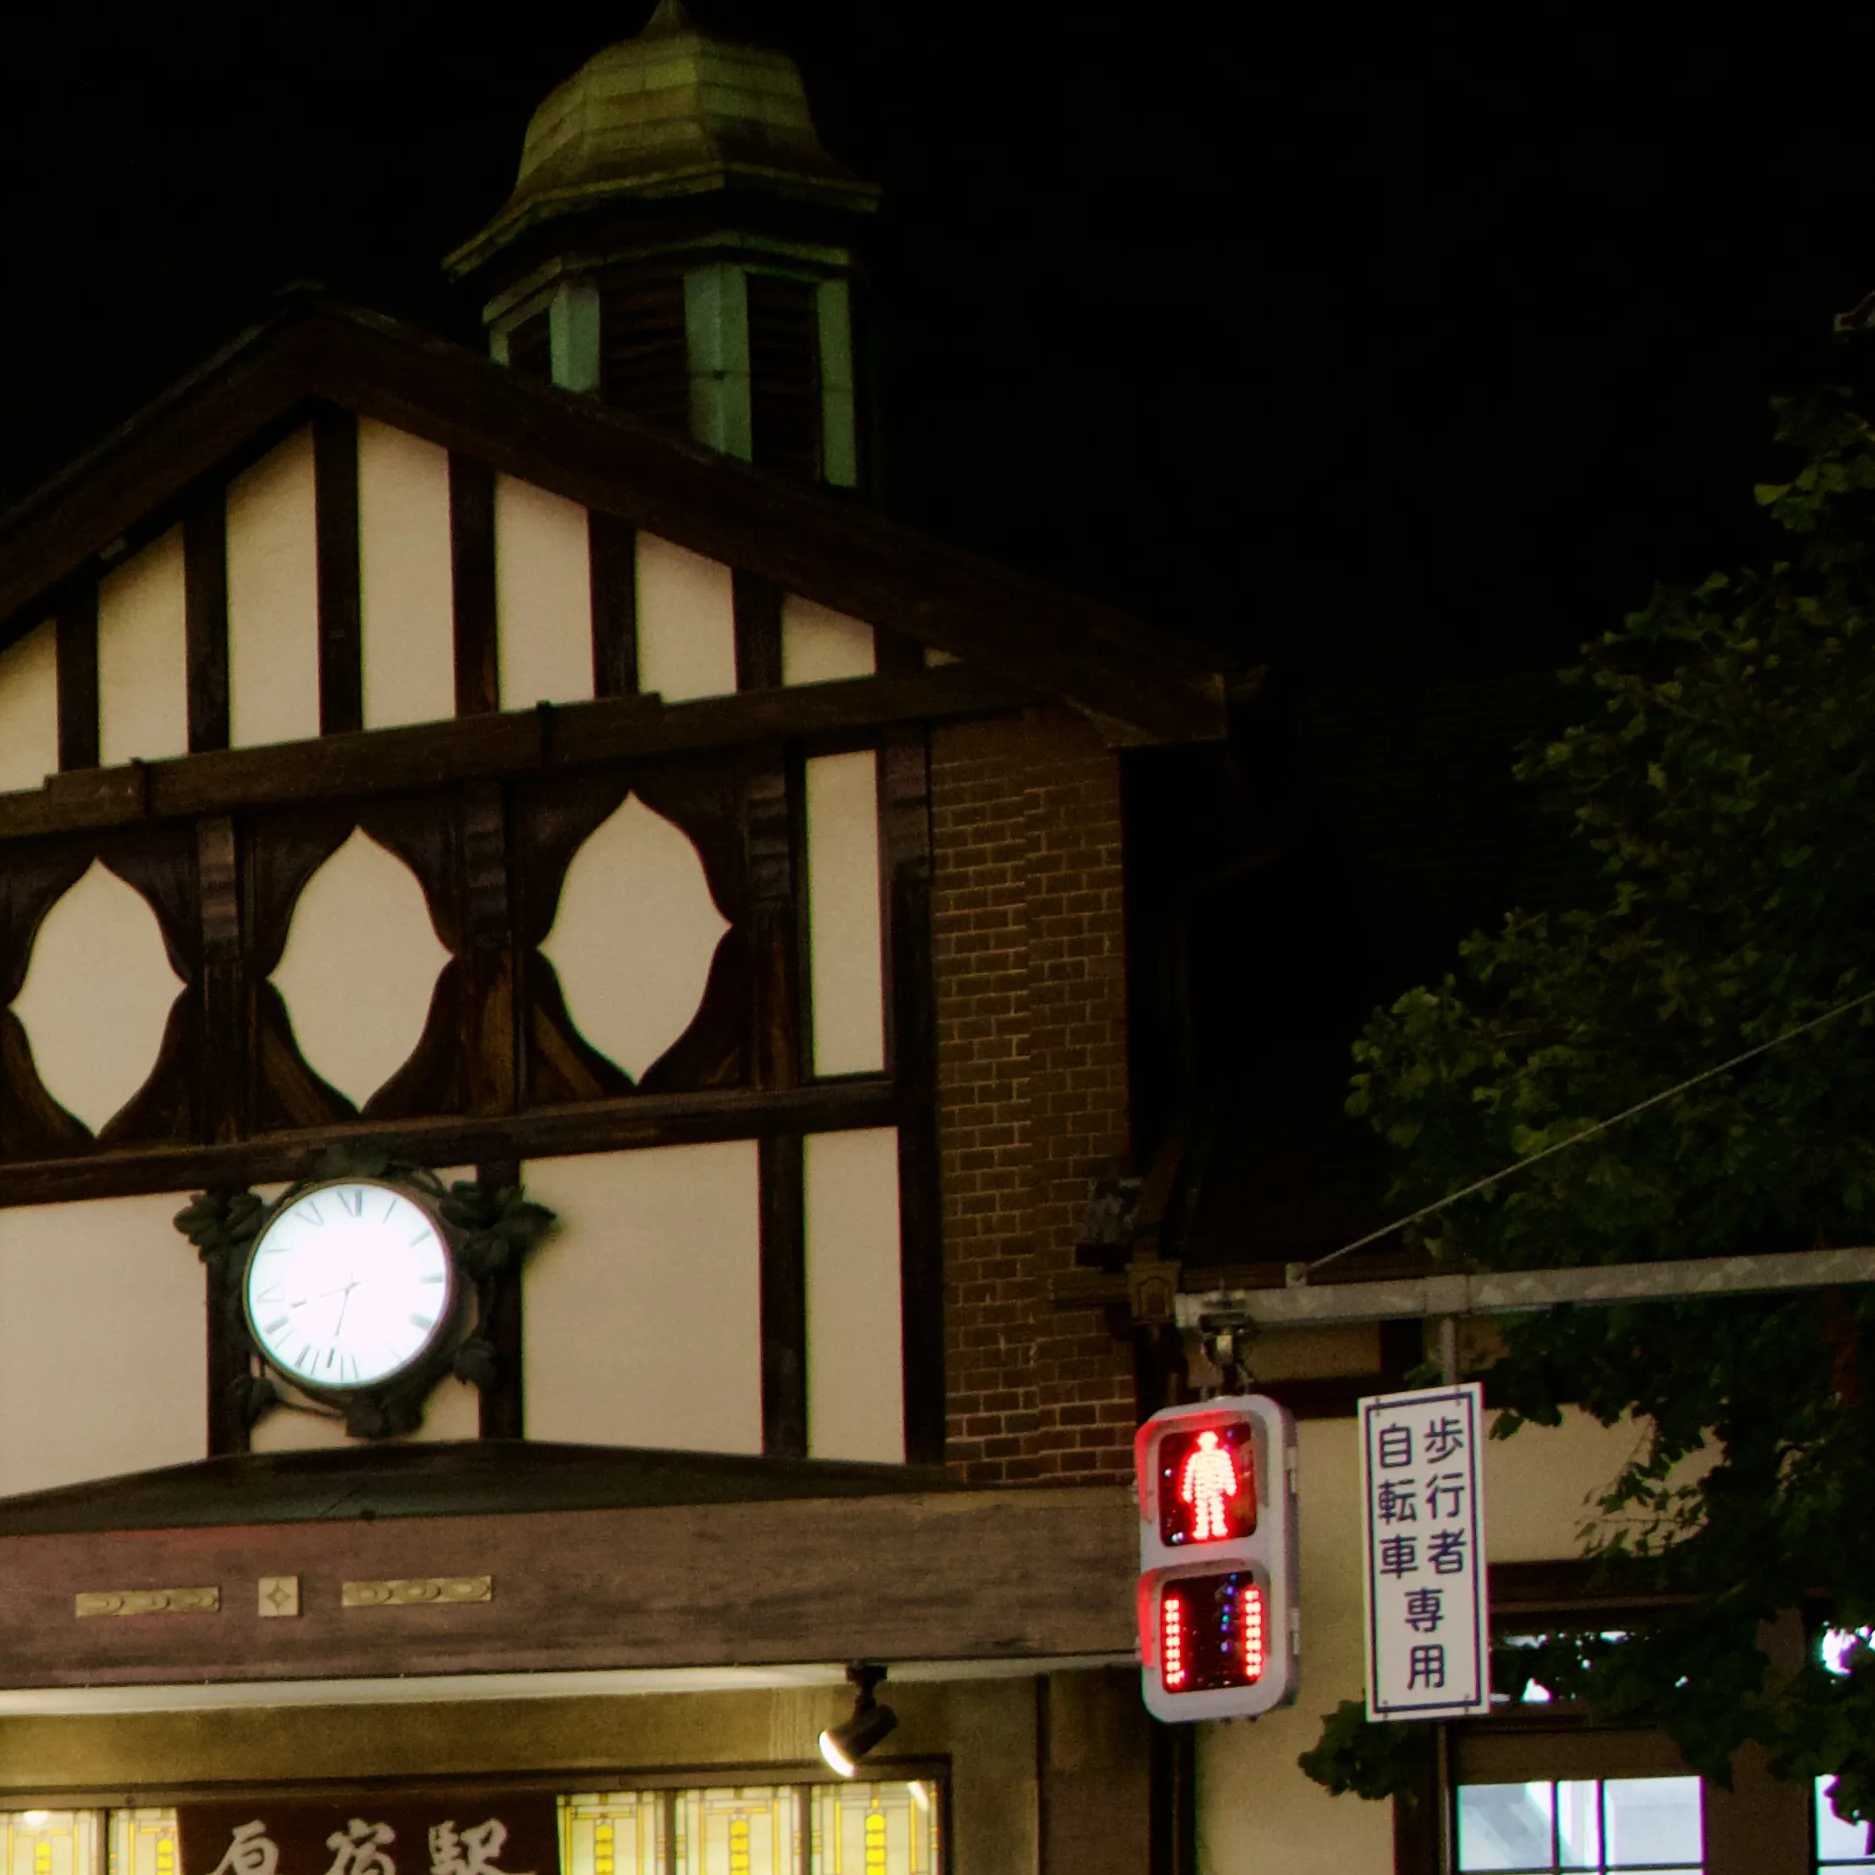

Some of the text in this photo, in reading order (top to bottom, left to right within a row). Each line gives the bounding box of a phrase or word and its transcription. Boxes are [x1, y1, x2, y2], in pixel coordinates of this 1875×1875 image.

[1377, 1422, 1419, 1579] 自転車
[1423, 1416, 1467, 1575] 歩行者
[1404, 1586, 1446, 1690] 専用
